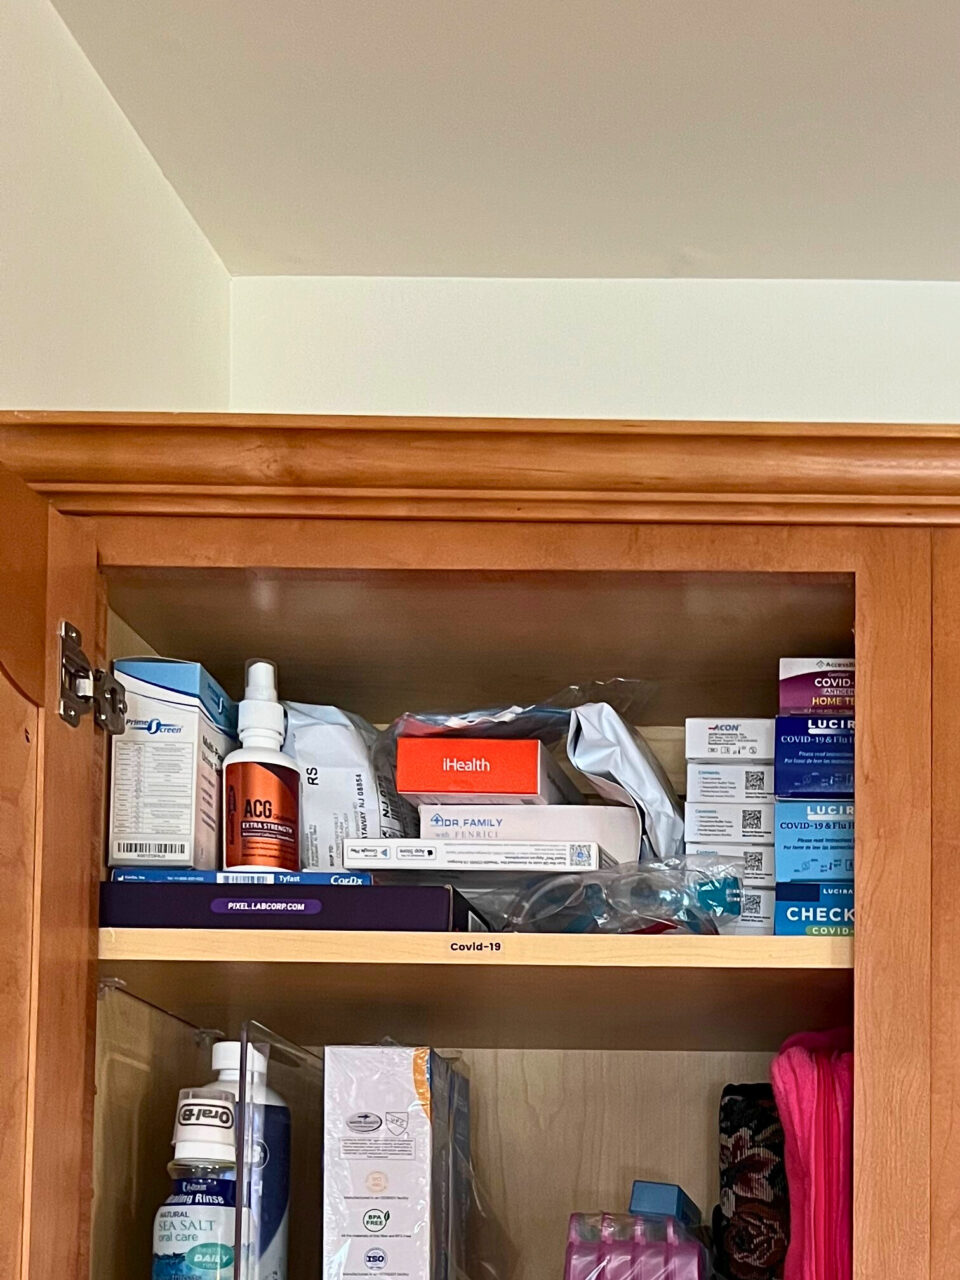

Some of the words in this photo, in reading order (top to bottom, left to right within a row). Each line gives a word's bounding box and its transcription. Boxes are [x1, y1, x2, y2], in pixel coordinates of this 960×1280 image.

[815, 679, 855, 687] COVID-
[812, 697, 840, 705] HOME
[126, 718, 149, 726] Prime
[808, 719, 855, 729] LUCIR
[713, 724, 739, 732] ACON
[781, 736, 825, 744] COVID-19
[825, 736, 832, 744] &
[443, 757, 490, 772] iHealth
[306, 767, 320, 786] RS
[358, 797, 366, 809] NJ
[243, 799, 273, 819] ACG
[381, 800, 391, 819] NJ
[807, 805, 855, 815] LUCIR
[463, 818, 503, 828] FAMILY
[780, 822, 823, 830] COVID-19
[242, 822, 263, 830] EXTRA
[263, 822, 293, 835] STRENGTH
[280, 874, 301, 884] Tyfast
[331, 874, 364, 886] CorDx
[787, 906, 855, 922] CHECK
[812, 926, 855, 935] COVID-
[450, 942, 501, 951] Covid-19
[182, 1108, 231, 1124] Oral-B
[196, 1194, 225, 1204] Rinse
[159, 1220, 177, 1231] SEA
[180, 1220, 216, 1231] SALT
[158, 1232, 173, 1242] oral
[175, 1233, 199, 1242] care
